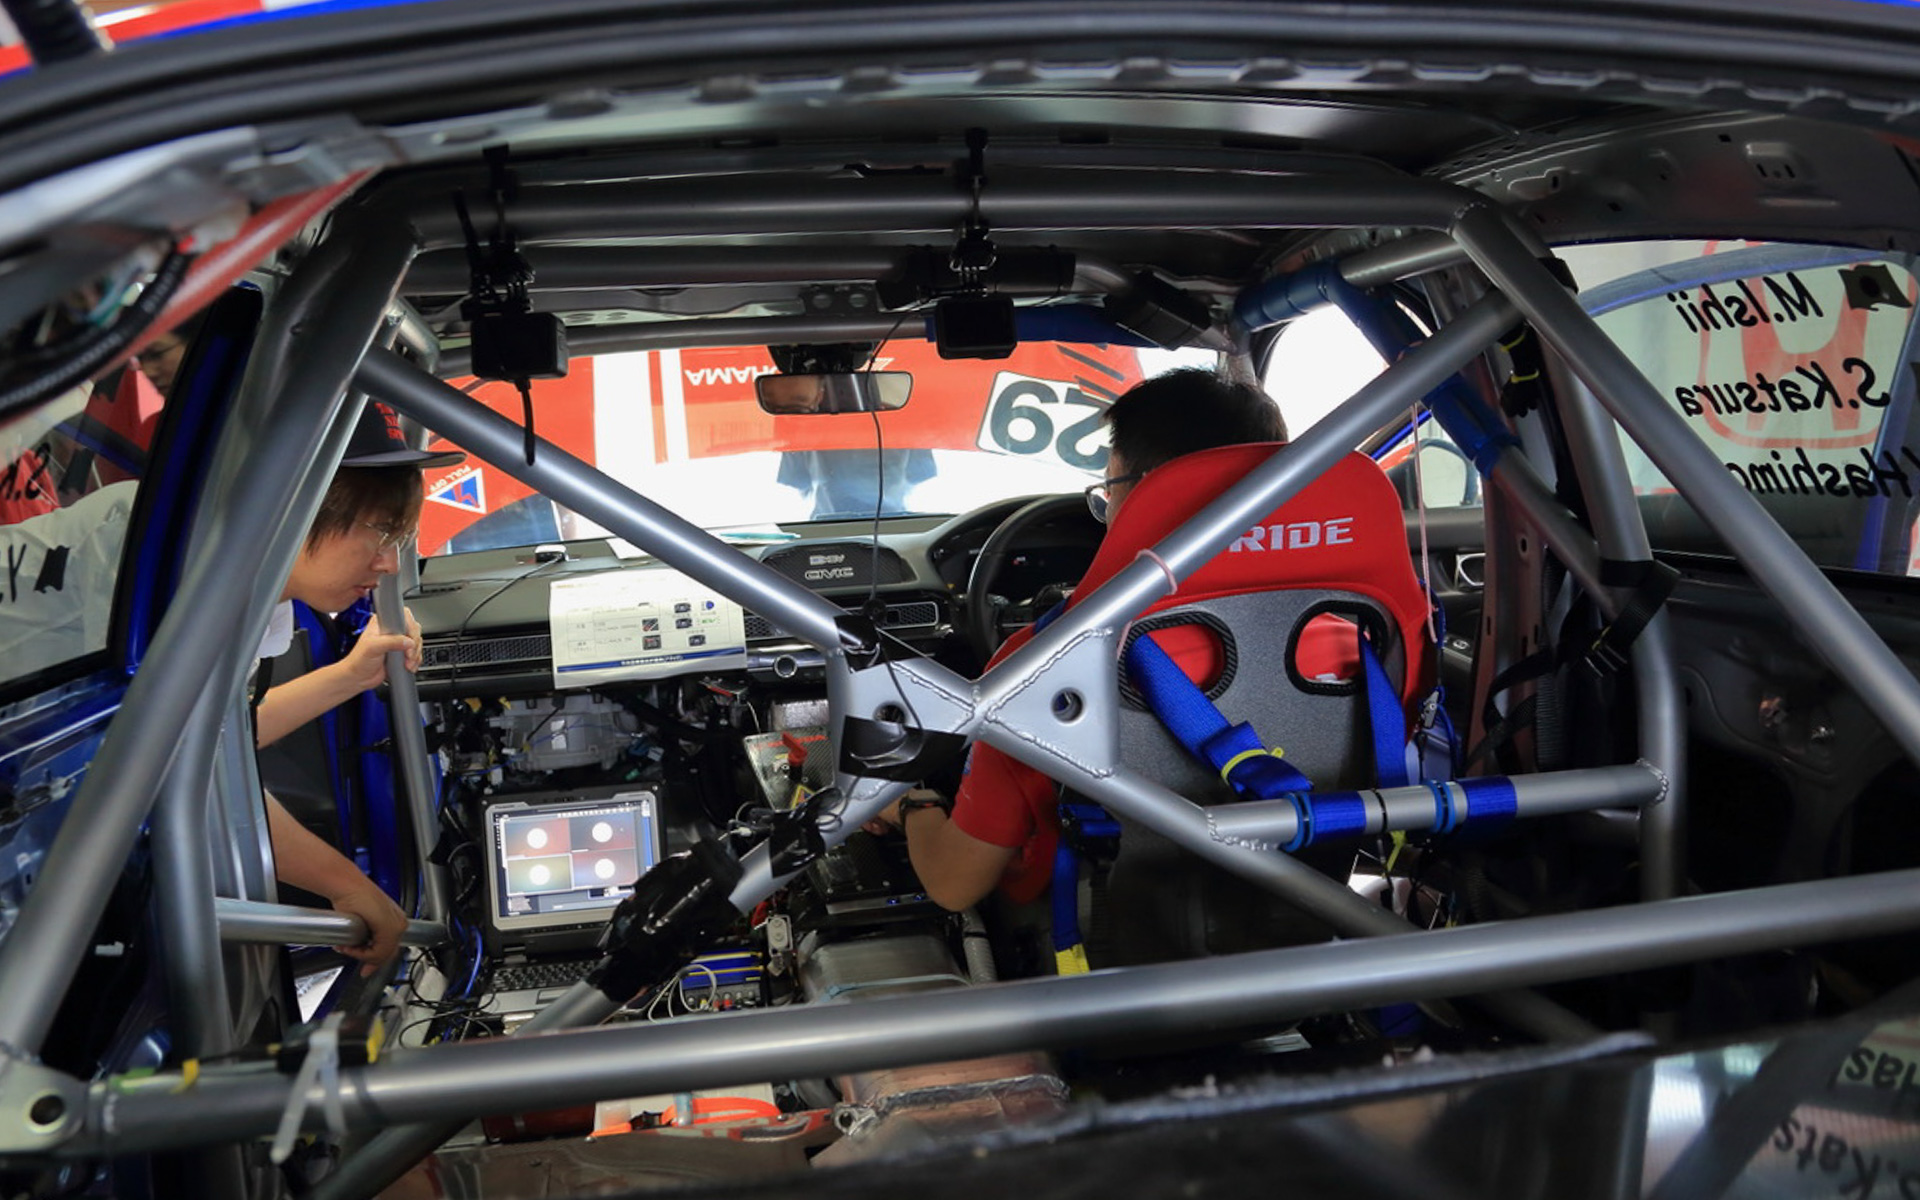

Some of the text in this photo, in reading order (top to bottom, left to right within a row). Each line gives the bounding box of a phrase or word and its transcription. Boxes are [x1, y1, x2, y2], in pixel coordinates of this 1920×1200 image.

[685, 364, 780, 386] HAMA
[990, 380, 1115, 470] 29
[1229, 517, 1354, 552] RIDE
